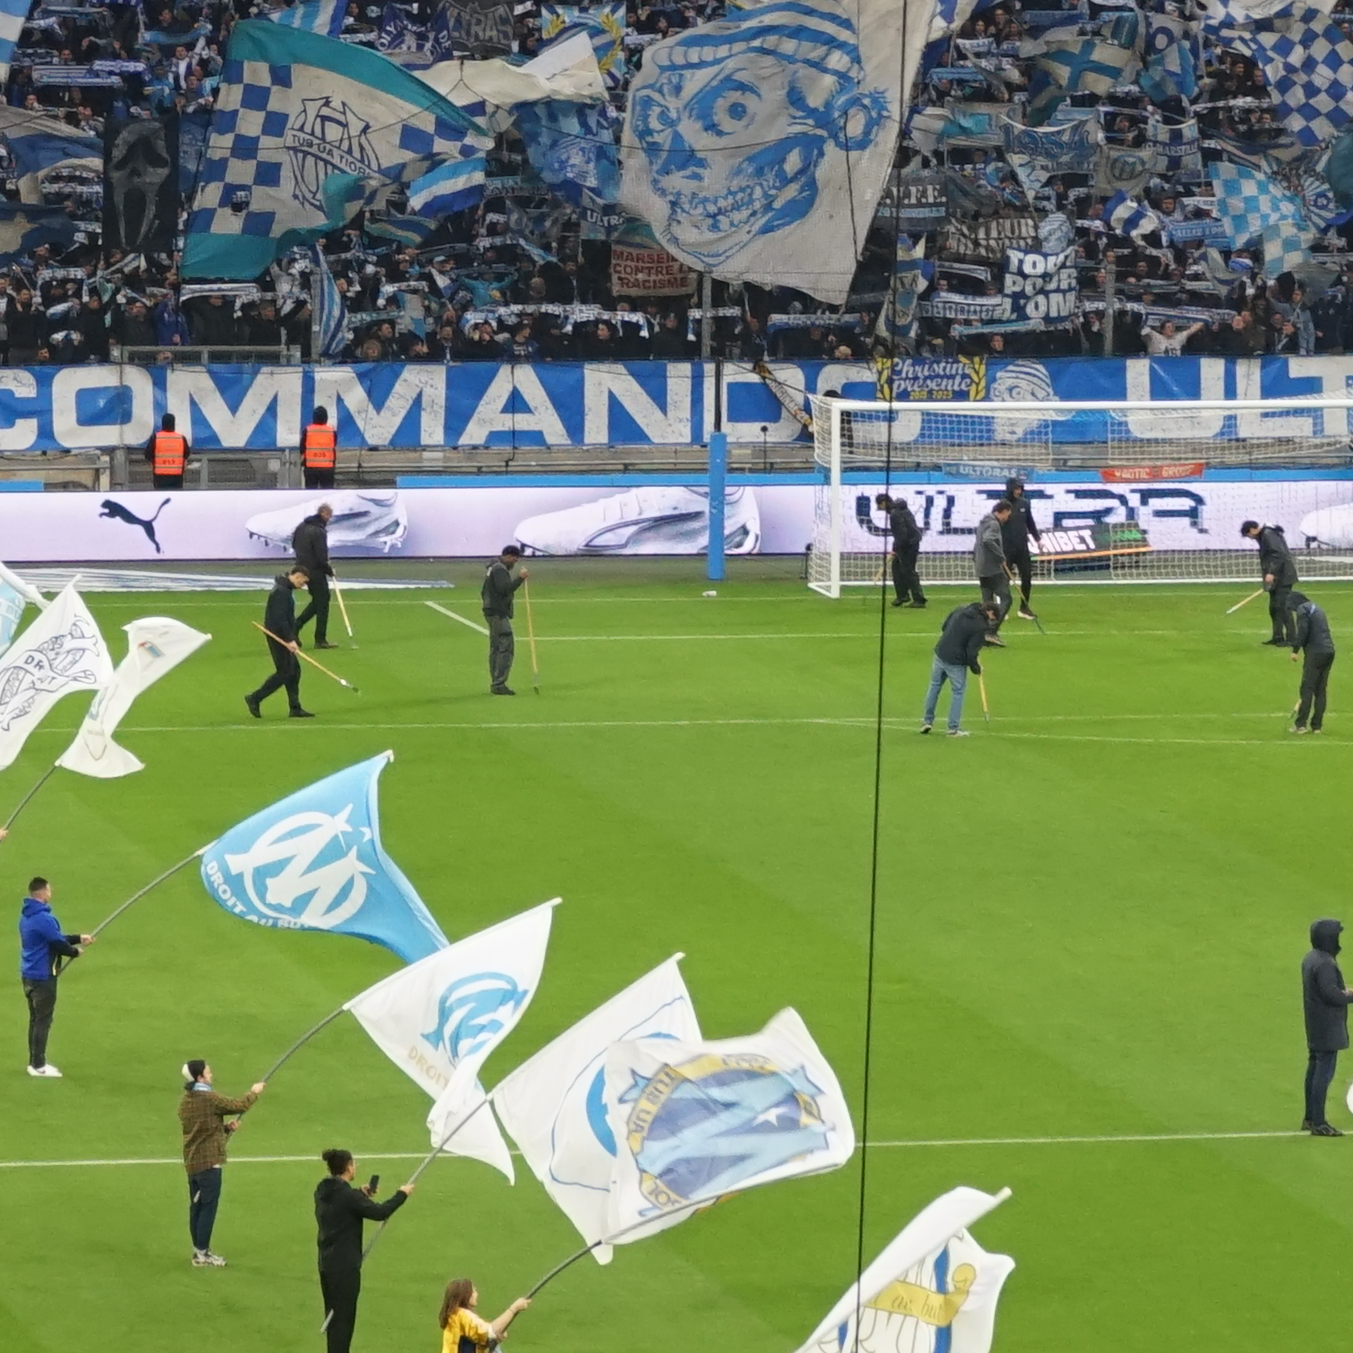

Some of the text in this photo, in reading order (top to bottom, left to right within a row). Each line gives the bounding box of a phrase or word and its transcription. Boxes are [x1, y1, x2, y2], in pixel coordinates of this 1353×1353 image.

[612, 263, 677, 277] CONTRE
[617, 276, 688, 290] RACISME
[205, 860, 246, 918] DROIT
